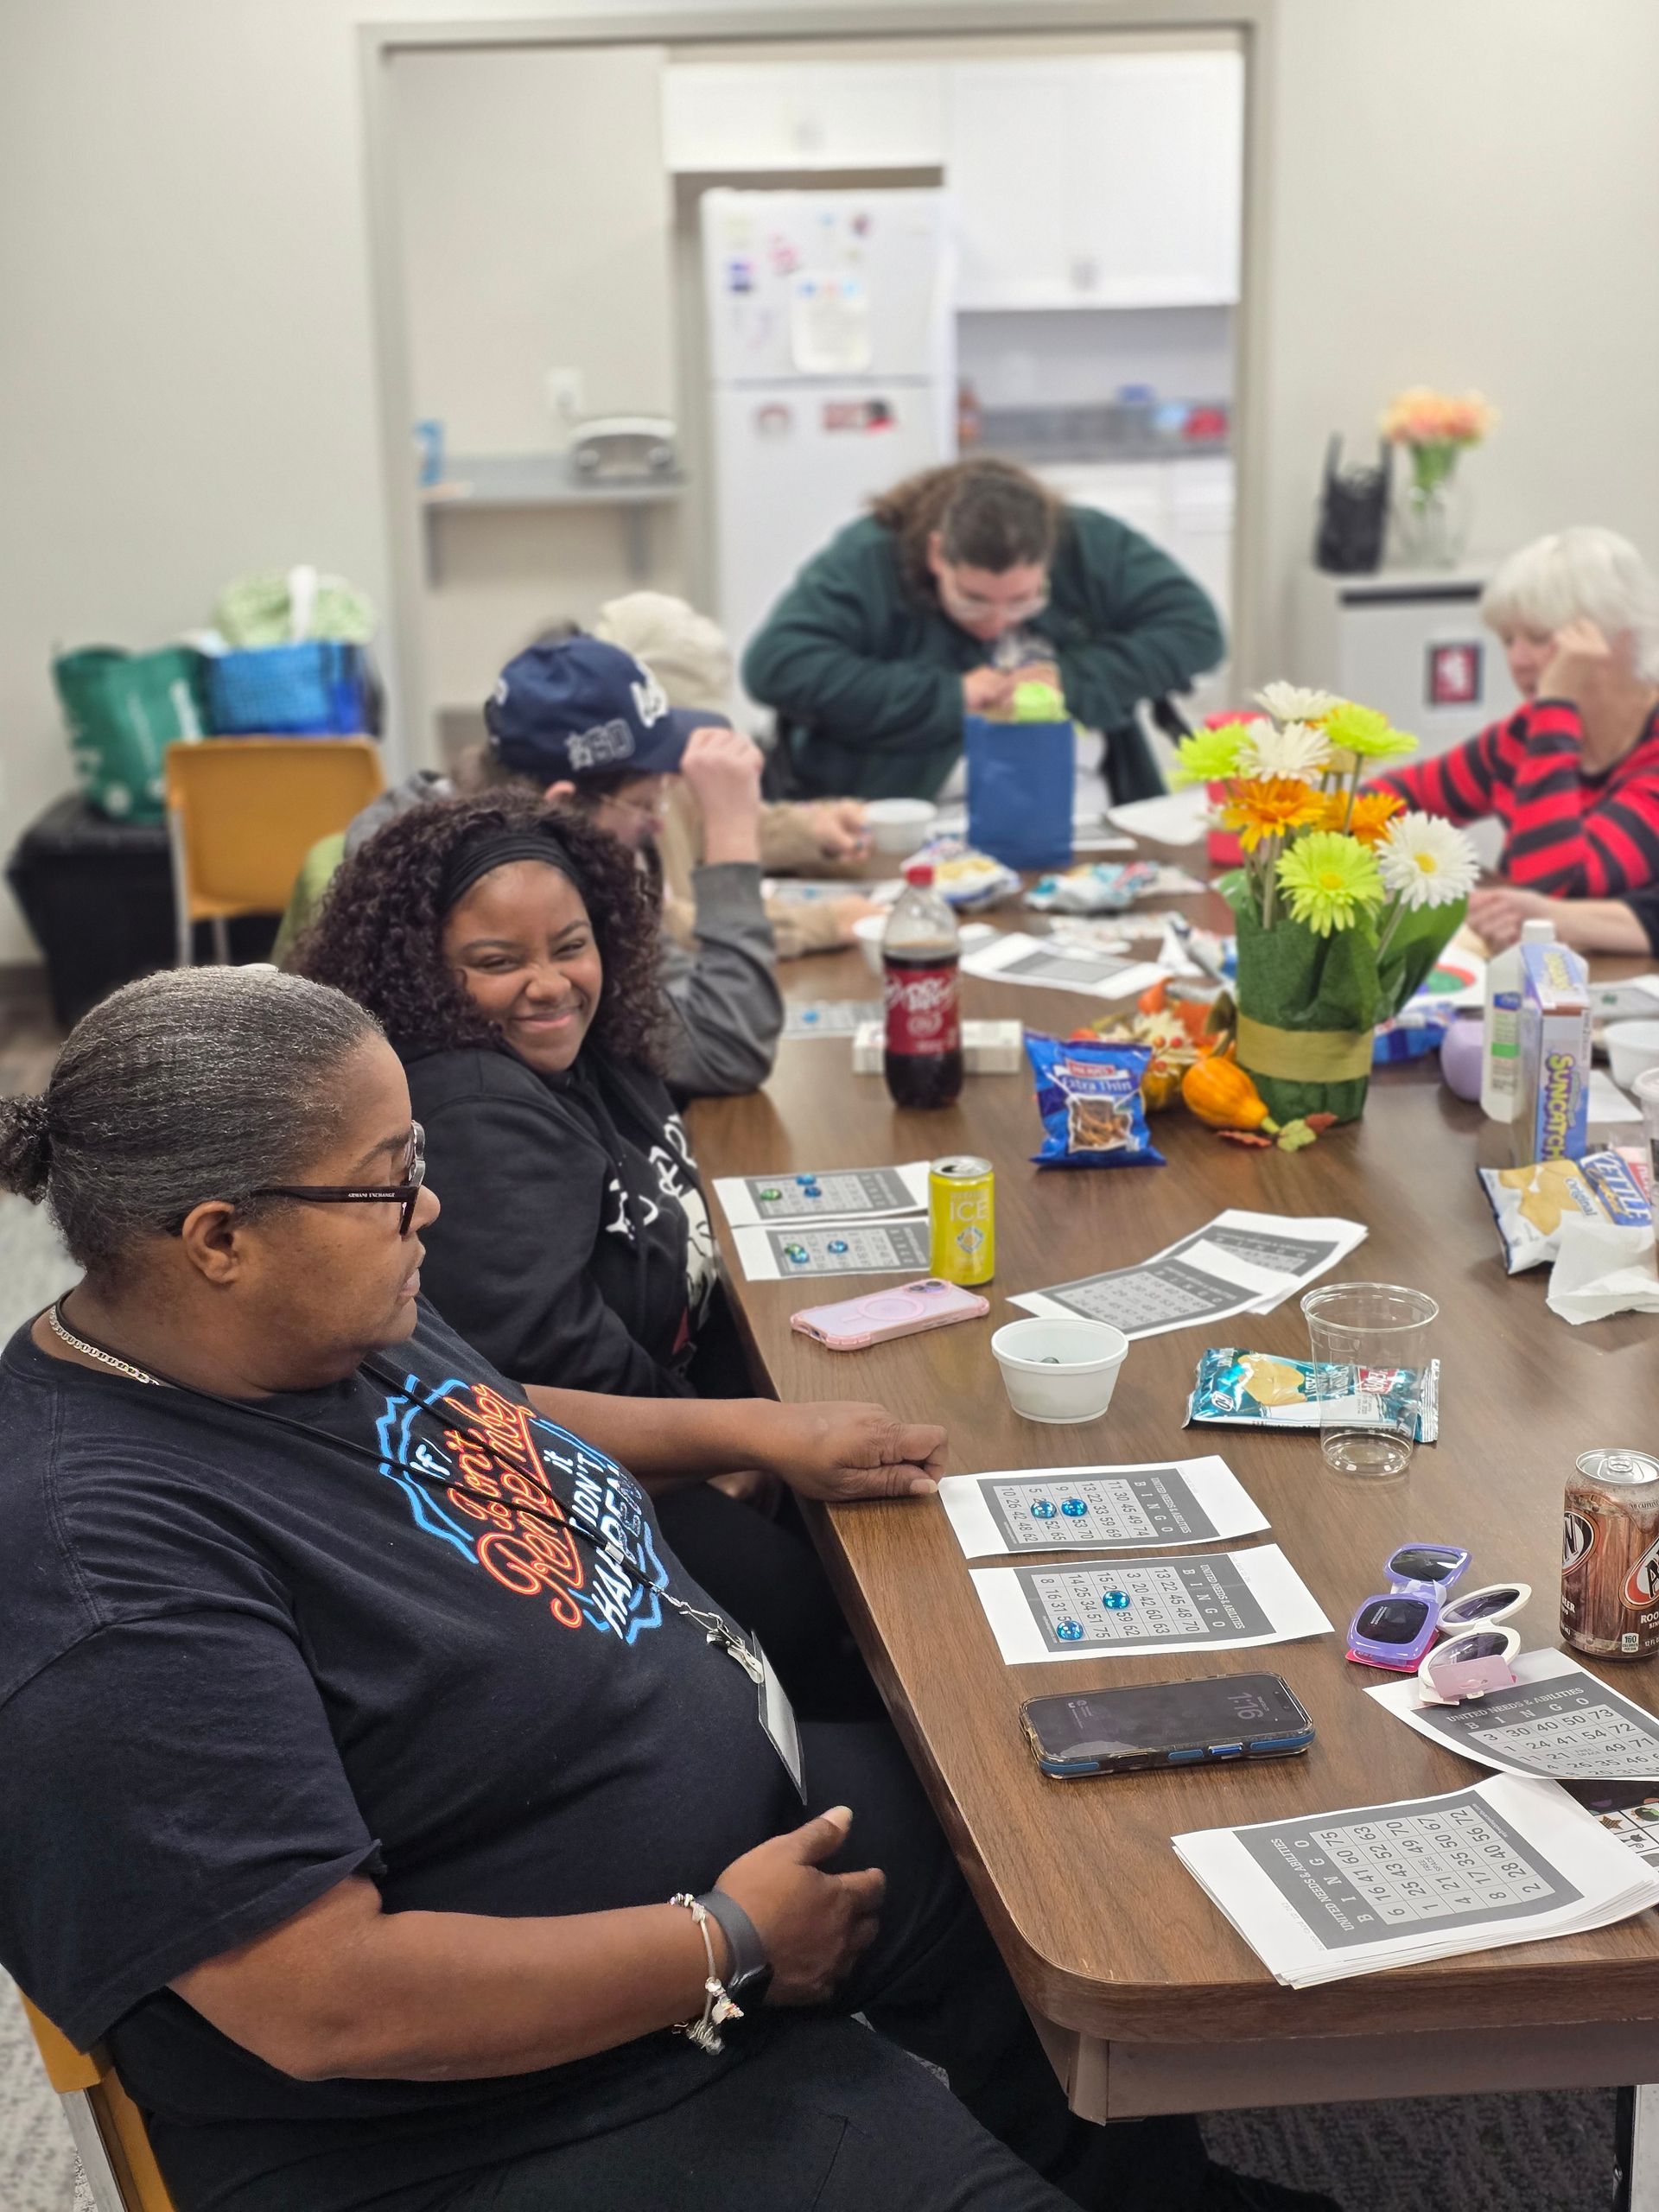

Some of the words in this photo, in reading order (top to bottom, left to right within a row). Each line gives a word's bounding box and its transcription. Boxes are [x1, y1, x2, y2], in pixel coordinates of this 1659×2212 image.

[1100, 1078, 1133, 1090] Thin
[1542, 1053, 1576, 1160] SUNCATCH
[1566, 1178, 1598, 1217] Original
[950, 1200, 989, 1223] ICE
[543, 1448, 574, 1474] it
[1001, 1487, 1016, 1497] 10
[1082, 1483, 1096, 1491] 13
[1108, 1481, 1123, 1491] 11
[1087, 1493, 1103, 1503] 22
[1114, 1491, 1130, 1502] 30
[442, 1382, 583, 1630] Remember
[1006, 1498, 1022, 1509] 26
[1093, 1504, 1109, 1515] 33
[1120, 1503, 1137, 1513] 45
[1151, 1478, 1166, 1493] UNITED
[1160, 1493, 1176, 1508] NEEDS
[1171, 1512, 1192, 1533] ABILITIES
[1012, 1511, 1027, 1521] 42
[1099, 1516, 1116, 1527] 59
[1127, 1515, 1142, 1524] 49
[1018, 1522, 1033, 1532] 48
[1045, 1521, 1060, 1529] 52
[1072, 1519, 1088, 1528] 53
[1023, 1533, 1039, 1542] 62
[1078, 1529, 1094, 1540] 70
[1106, 1528, 1122, 1538] 69
[1134, 1527, 1150, 1537] 74
[1068, 1574, 1085, 1584] 14
[1096, 1573, 1114, 1583] 15
[1154, 1568, 1171, 1579] 13
[1073, 1586, 1091, 1599] 25
[1132, 1582, 1148, 1593] 20
[1160, 1581, 1178, 1592] 22
[1046, 1589, 1061, 1599] 16
[1168, 1594, 1185, 1605] 45
[1200, 1564, 1217, 1583] UNITED
[1211, 1583, 1228, 1599] NEEDS
[1223, 1605, 1245, 1629] ABILITIES
[1051, 1602, 1067, 1612] 31
[1080, 1600, 1097, 1611] 34
[1141, 1596, 1156, 1607] 42
[1087, 1613, 1104, 1624] 51
[1116, 1611, 1133, 1623] 59
[1146, 1609, 1163, 1620] 60
[1175, 1607, 1192, 1618] 48
[1640, 1611, 1659, 1624] ROO
[1093, 1626, 1110, 1637] 75
[1122, 1624, 1141, 1636] 62
[1153, 1623, 1170, 1634] 63
[1181, 1621, 1200, 1631] 70
[1227, 1692, 1263, 1719] 1:16
[1446, 1709, 1488, 1723] UNITED
[1488, 1700, 1524, 1714] NEEDS
[1524, 1697, 1533, 1706] &
[1534, 1687, 1585, 1703] ABILITIES
[1465, 1721, 1479, 1730] B
[1521, 1710, 1536, 1719] N
[1549, 1704, 1563, 1713] G
[1576, 1697, 1589, 1706] O
[1505, 1726, 1530, 1738] 30
[1536, 1721, 1559, 1732] 40
[1562, 1715, 1586, 1726] 50
[1588, 1708, 1614, 1719] 73
[1526, 1740, 1551, 1750] 24
[1556, 1736, 1578, 1745] 41
[1581, 1730, 1606, 1740] 54
[1608, 1723, 1636, 1733] 72
[1605, 1743, 1626, 1752] 49
[1628, 1738, 1654, 1747] 71
[1450, 1809, 1474, 1826] 72
[1386, 1821, 1409, 1836] 70
[1417, 1817, 1441, 1832] 67
[1320, 1832, 1344, 1847] 75
[1354, 1827, 1376, 1840] 63
[1466, 1827, 1491, 1842] 56
[1294, 1840, 1310, 1848] O
[1402, 1840, 1424, 1853] 49
[1434, 1834, 1459, 1848] 50
[1270, 1838, 1306, 1872] ABILITIES
[1337, 1850, 1359, 1864] 60
[1370, 1844, 1393, 1859] 52
[1484, 1845, 1506, 1859] 40
[1309, 1858, 1325, 1866] G
[1425, 1856, 1443, 1872] SPACE
[1450, 1852, 1475, 1866] 35
[1385, 1863, 1408, 1878] 43
[1418, 1859, 1432, 1872] FREE
[1501, 1862, 1527, 1878] 28
[1324, 1877, 1342, 1885] N
[1353, 1869, 1375, 1882] 41
[1466, 1871, 1491, 1885] 17
[1401, 1881, 1427, 1896] 25
[1435, 1877, 1460, 1891] 21
[1522, 1883, 1541, 1893] 2
[1304, 1878, 1332, 1903] NEEDS
[1368, 1887, 1392, 1901] 16
[1325, 1903, 1355, 1931] UNITED
[1357, 1913, 1375, 1923] B
[1388, 1908, 1405, 1916] 6
